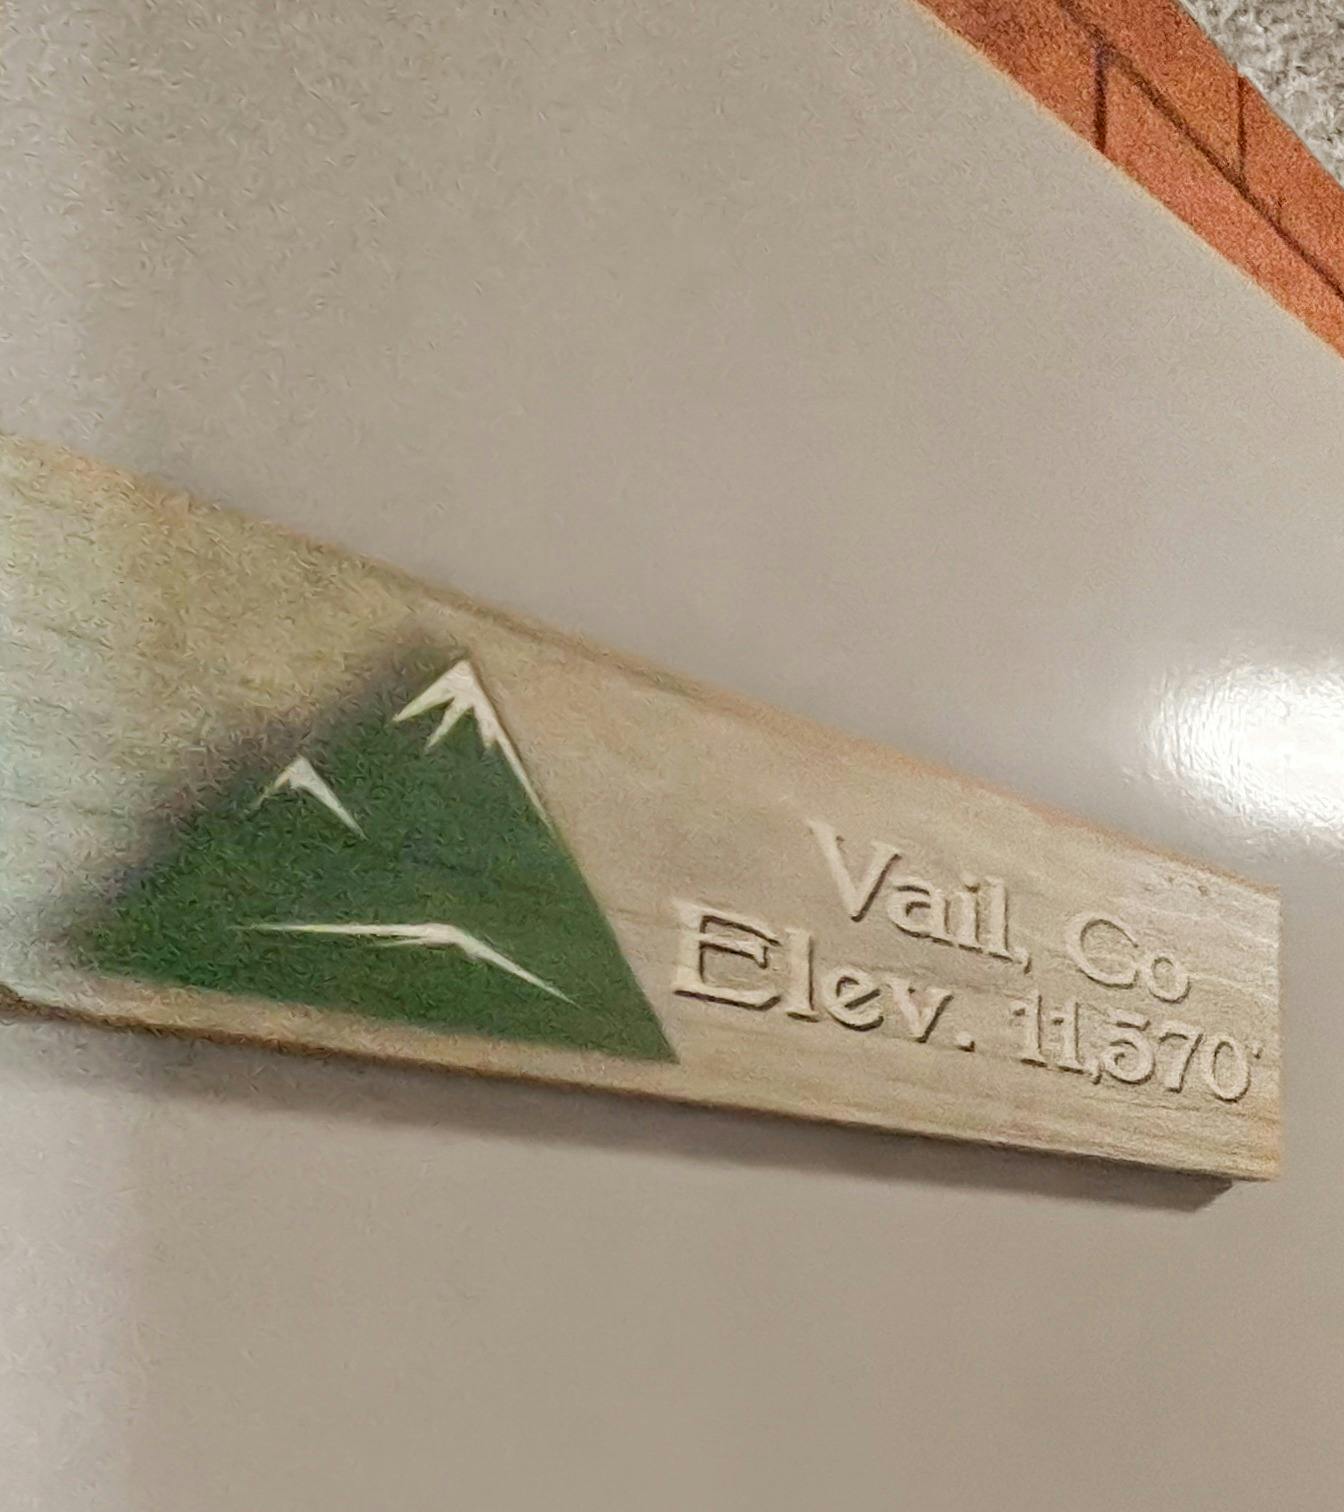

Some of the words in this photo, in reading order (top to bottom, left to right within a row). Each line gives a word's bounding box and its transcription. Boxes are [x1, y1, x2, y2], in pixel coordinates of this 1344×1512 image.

[672, 898, 975, 1053] Elev.
[806, 817, 1033, 975] Vail,
[1063, 911, 1190, 1004] Co
